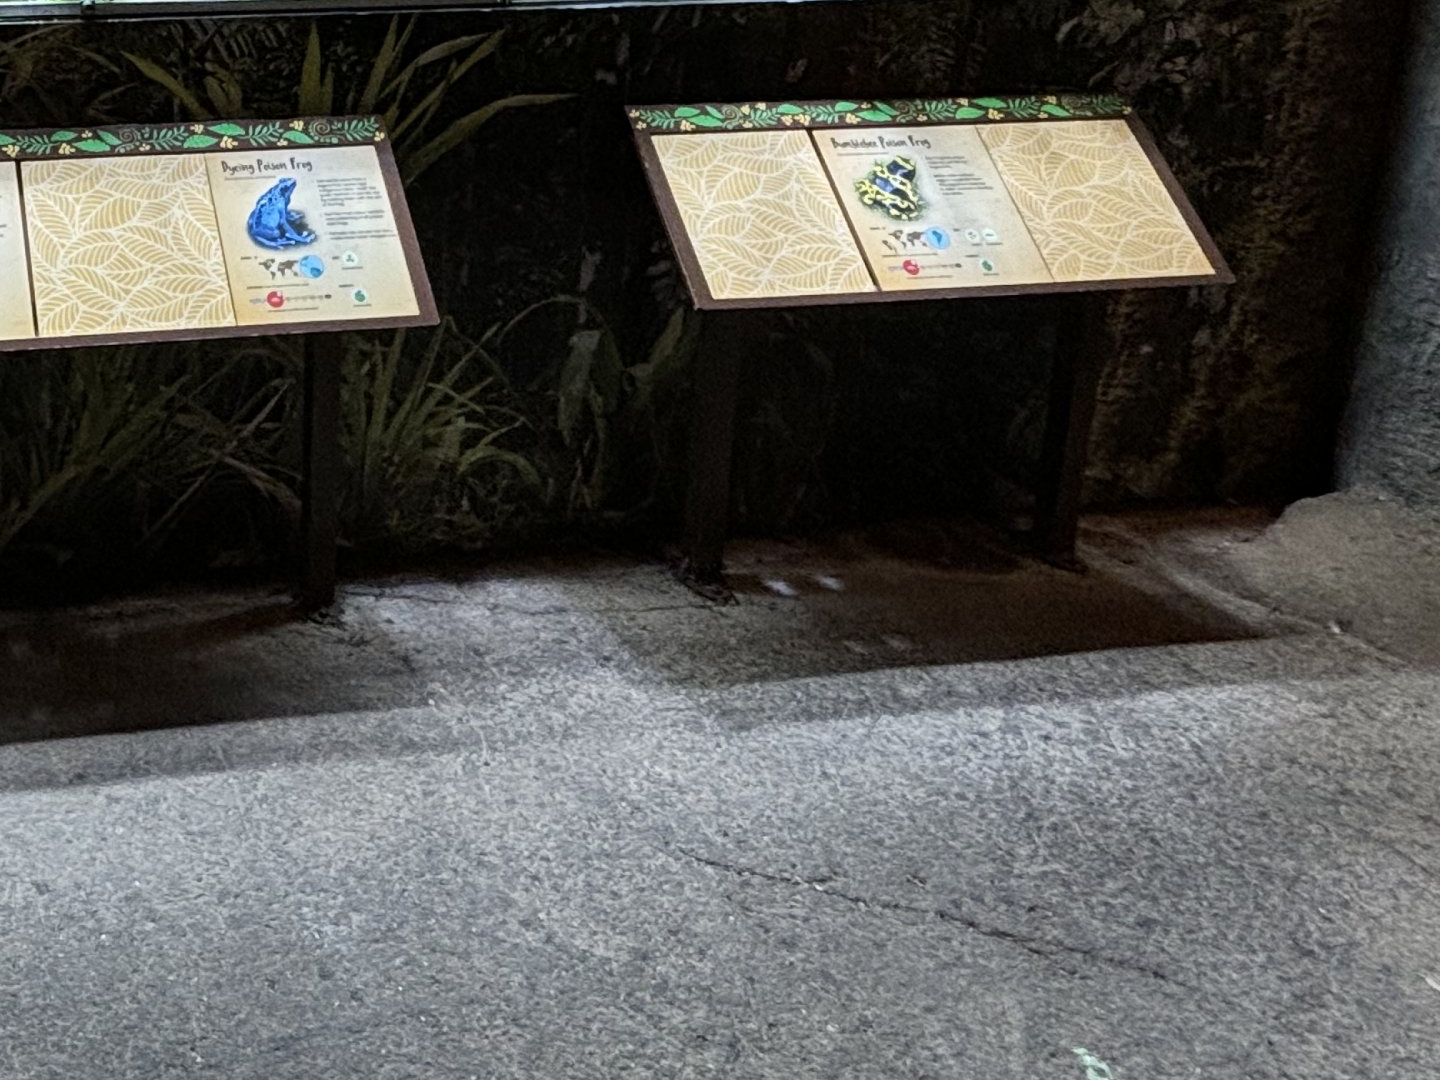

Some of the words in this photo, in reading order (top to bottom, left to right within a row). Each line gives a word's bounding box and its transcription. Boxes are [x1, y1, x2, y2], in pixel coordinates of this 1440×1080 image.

[879, 136, 908, 149] Poison
[908, 135, 931, 149] Frog
[221, 160, 255, 175] Dyeing
[257, 158, 288, 172] Poison
[290, 157, 313, 171] Frog
